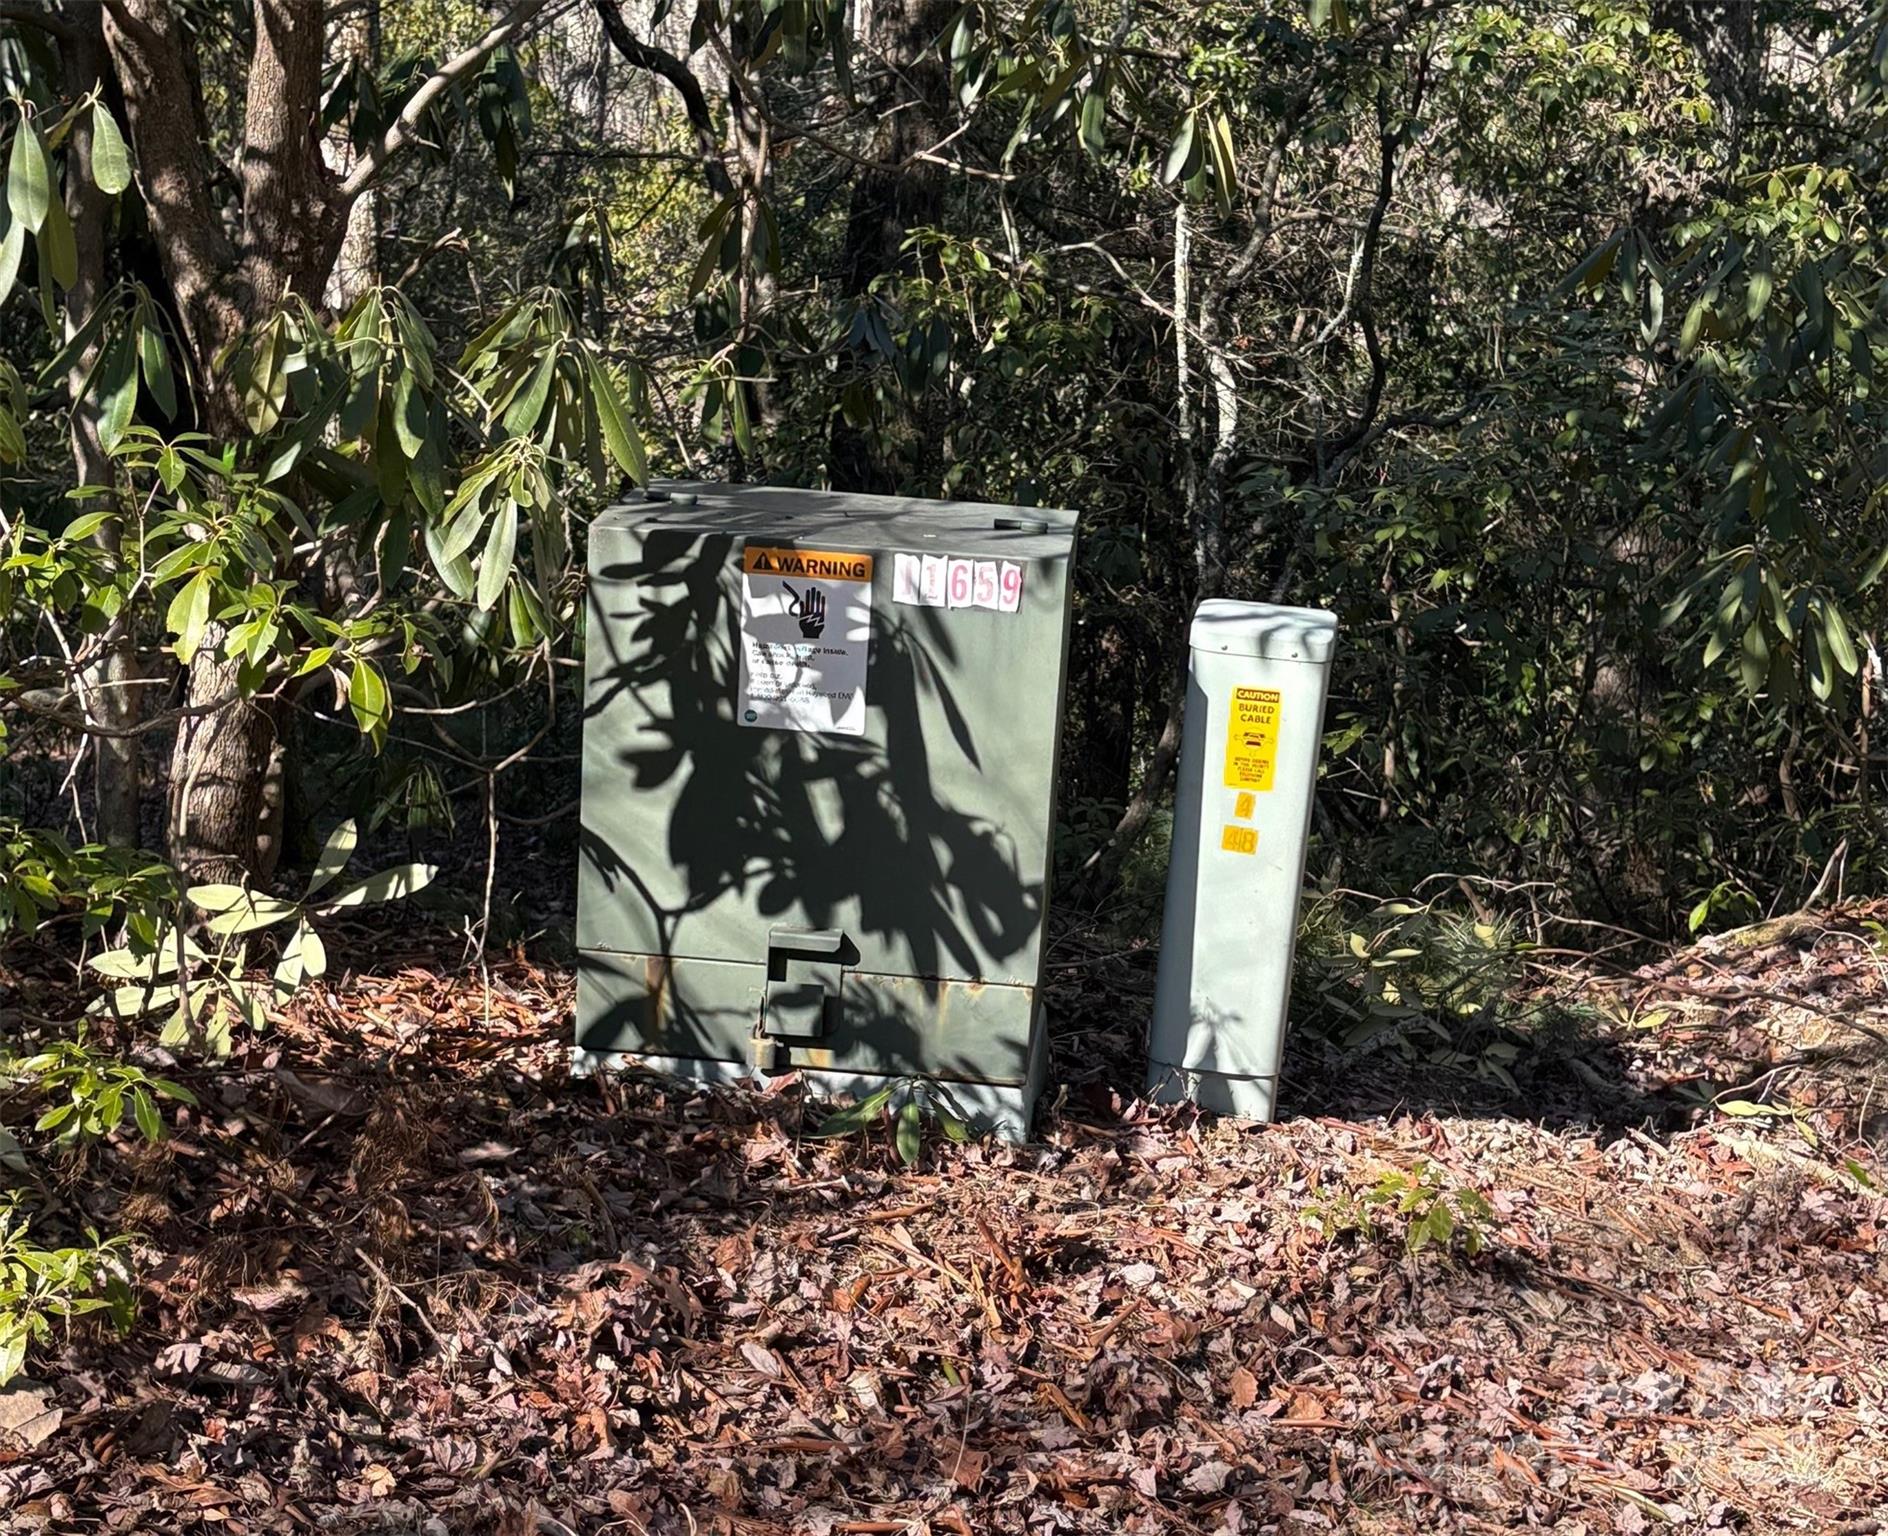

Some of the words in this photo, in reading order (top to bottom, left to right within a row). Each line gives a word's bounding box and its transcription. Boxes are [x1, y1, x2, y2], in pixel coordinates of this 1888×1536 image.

[777, 556, 866, 578] WARNING
[902, 561, 1020, 605] 11659
[1237, 690, 1278, 702] CAUTION
[1239, 703, 1275, 714] BURIED
[1240, 714, 1271, 724] CABLE
[1239, 797, 1251, 817] 4
[1226, 831, 1256, 853] 48
